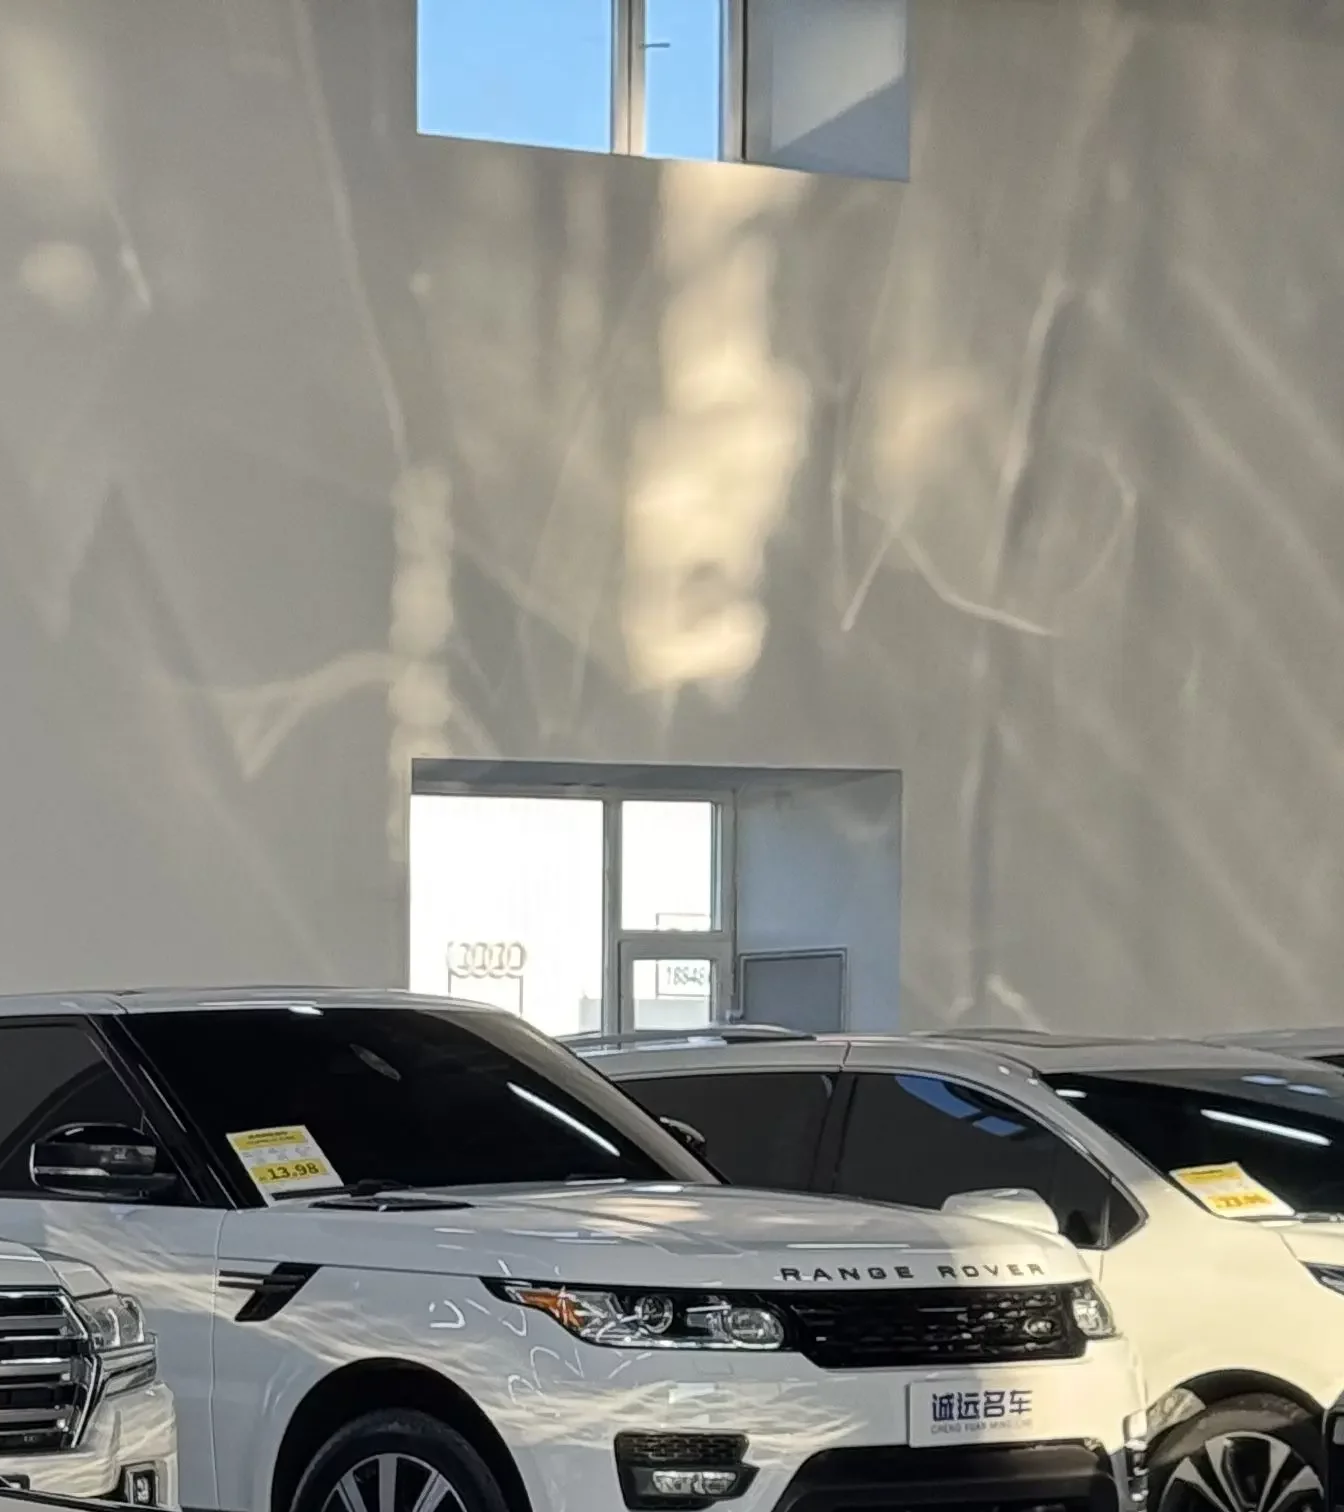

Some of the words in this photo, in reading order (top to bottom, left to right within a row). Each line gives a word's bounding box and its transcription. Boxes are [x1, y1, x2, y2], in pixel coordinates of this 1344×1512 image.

[267, 1161, 320, 1180] 13.98
[780, 1266, 914, 1282] RANGE
[937, 1263, 1044, 1279] ROVER
[932, 1389, 1033, 1421] 诚远名车
